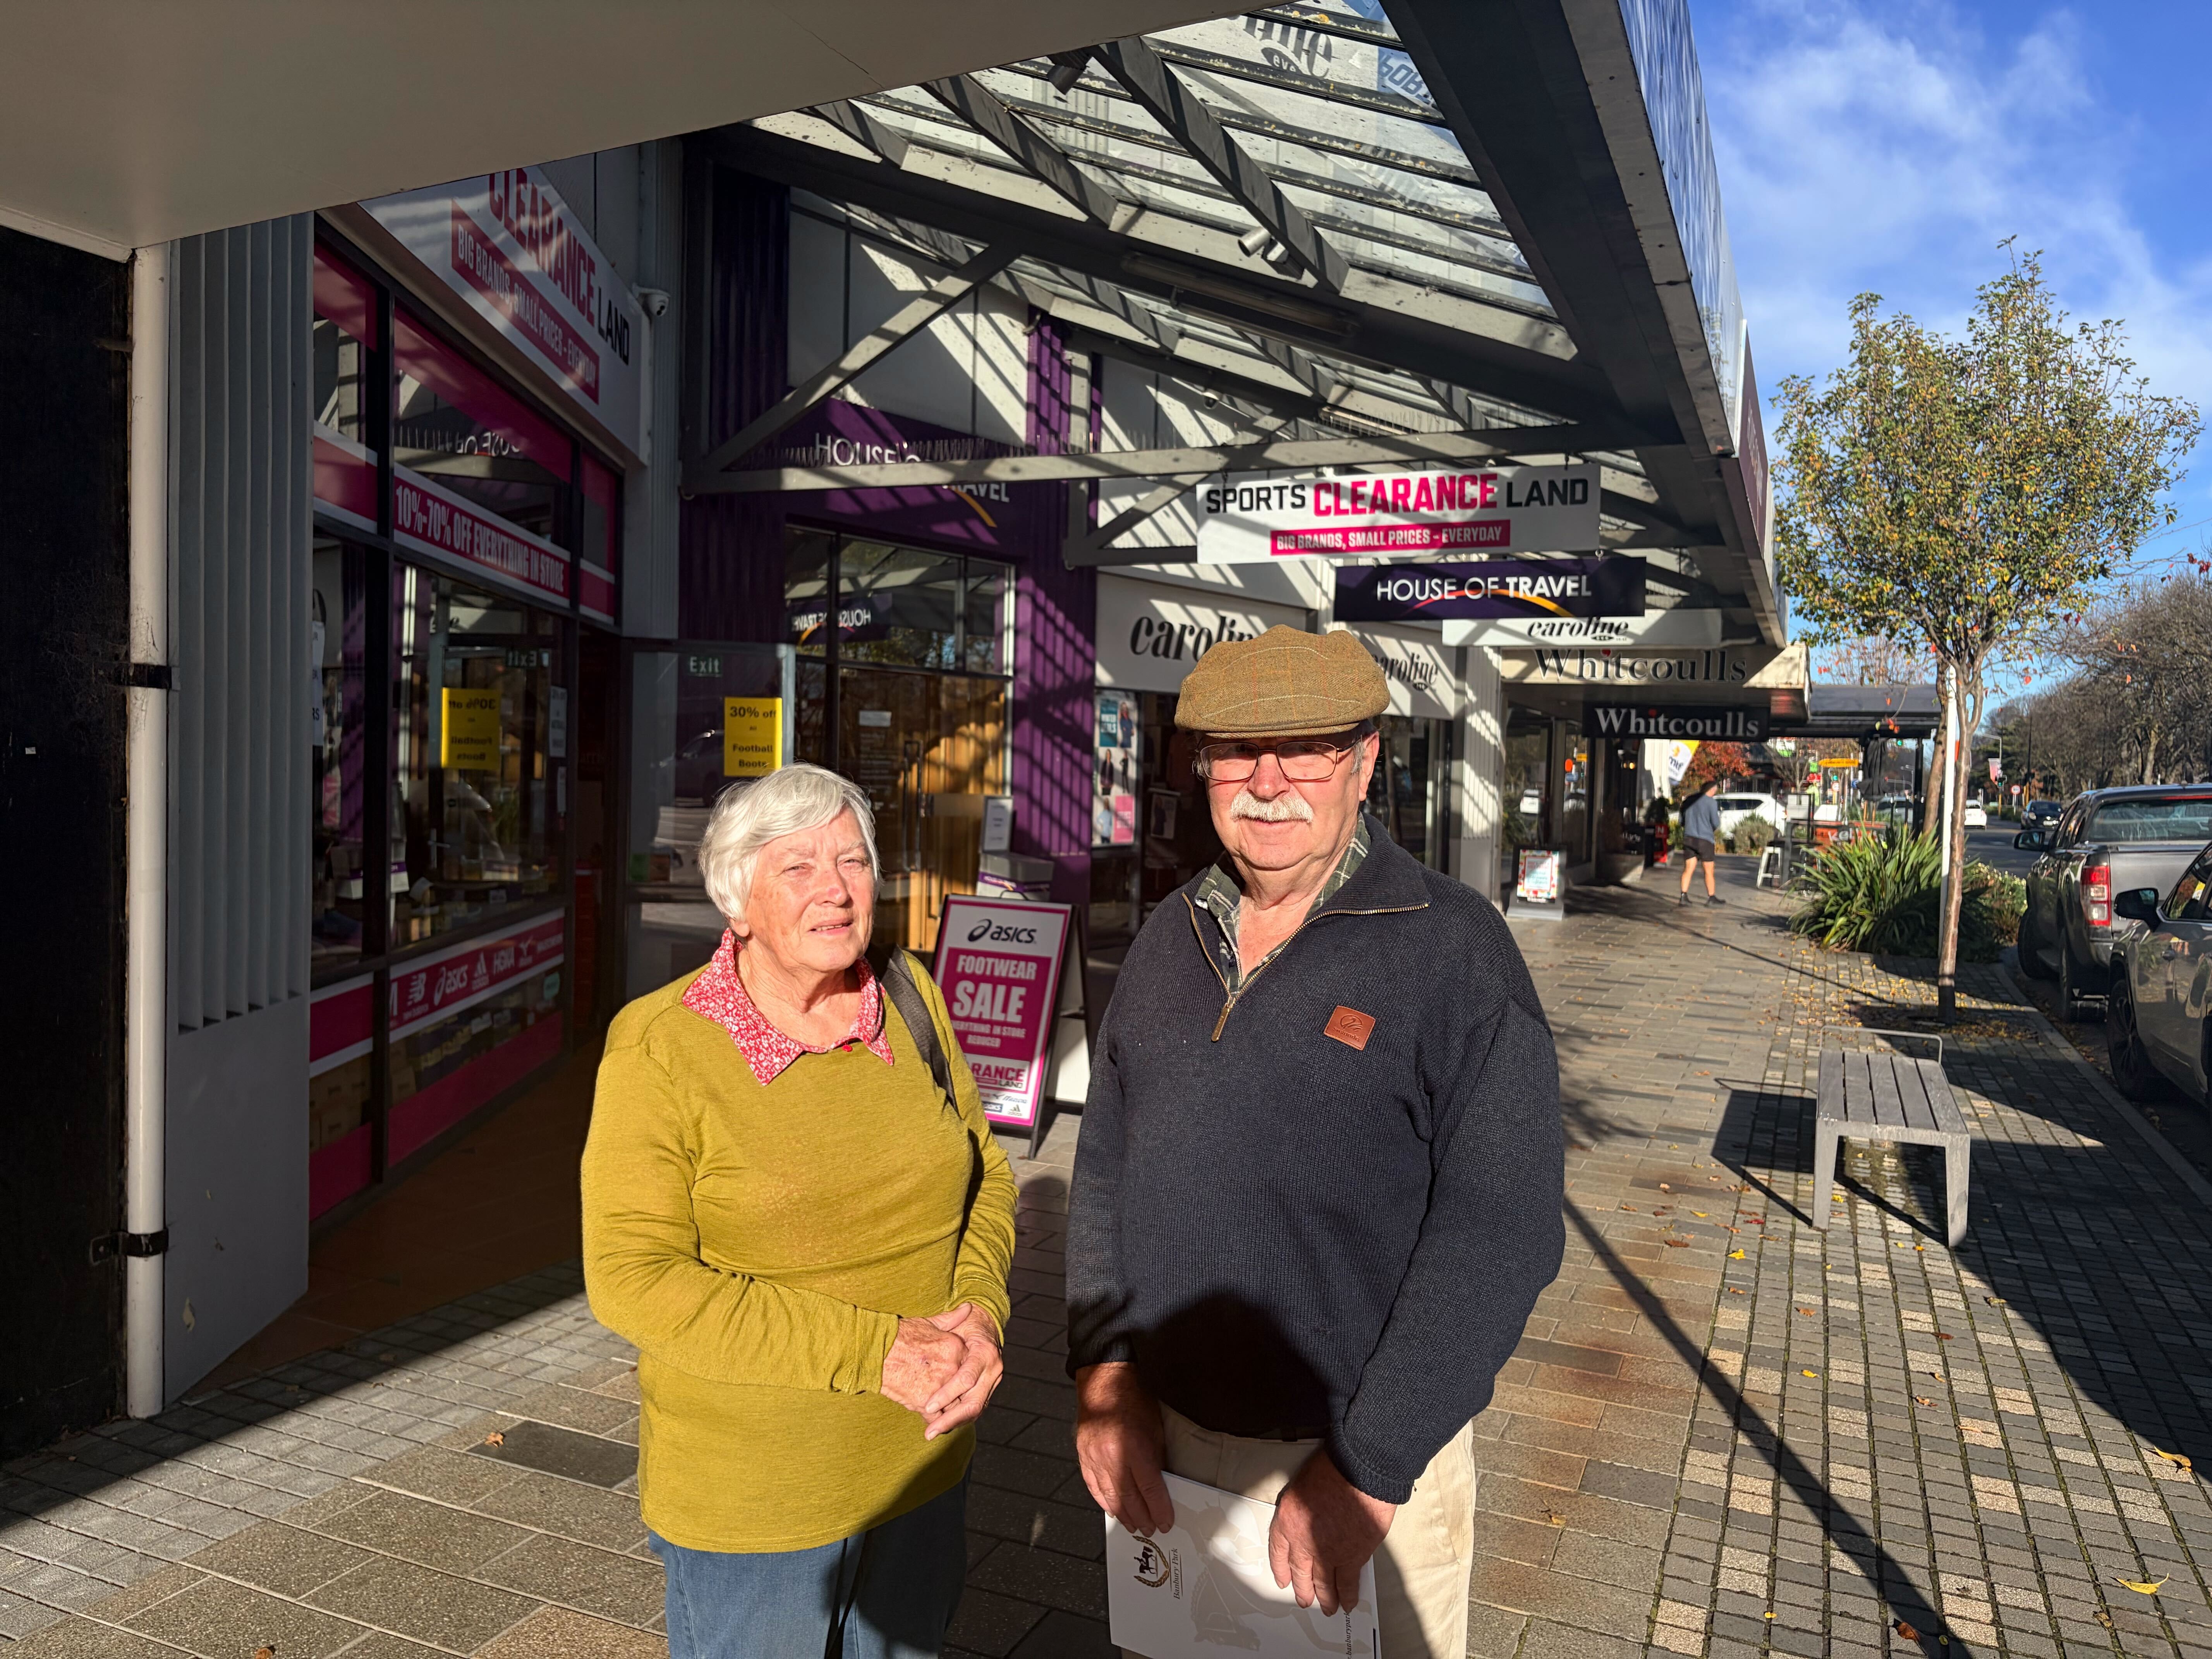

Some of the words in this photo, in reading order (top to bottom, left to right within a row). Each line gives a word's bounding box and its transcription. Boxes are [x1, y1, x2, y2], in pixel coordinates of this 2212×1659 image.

[489, 168, 595, 327] CLEARANCE
[598, 287, 629, 365] LAND
[458, 224, 474, 270] BIG
[514, 282, 538, 332] SMALL
[539, 308, 563, 357] PRICES
[1206, 484, 1306, 514] SPORTS
[1313, 473, 1498, 517] CLEARANCE
[1506, 478, 1588, 508] LAND
[396, 484, 452, 546] 10%-70%
[453, 512, 472, 554] OFF
[473, 520, 529, 578] EVERYTHING
[529, 548, 540, 583] IN
[540, 553, 565, 593] STORE
[1276, 536, 1296, 550] BIG
[1297, 533, 1347, 550] BRANDS,
[1348, 531, 1386, 547] SMALL
[1388, 529, 1431, 545] PRICES
[1442, 526, 1502, 543] EVERYDAY
[1377, 578, 1457, 601] HOUSE
[1464, 577, 1499, 600] OF
[1506, 575, 1592, 598] TRAVEL
[1130, 616, 1255, 663] carol
[1528, 617, 1629, 637] caroline
[690, 656, 719, 673] Exit
[1534, 649, 1747, 682] Whitcoulls
[729, 706, 759, 718] 30%
[763, 710, 776, 718] off
[1594, 708, 1759, 736] Whitcoulls
[732, 744, 774, 753] Football
[739, 760, 767, 768] Boots
[990, 926, 1037, 944] asics
[956, 954, 1038, 981] FOOTWEAR
[951, 980, 1027, 1024] SALE
[972, 1062, 1025, 1082] RANCE
